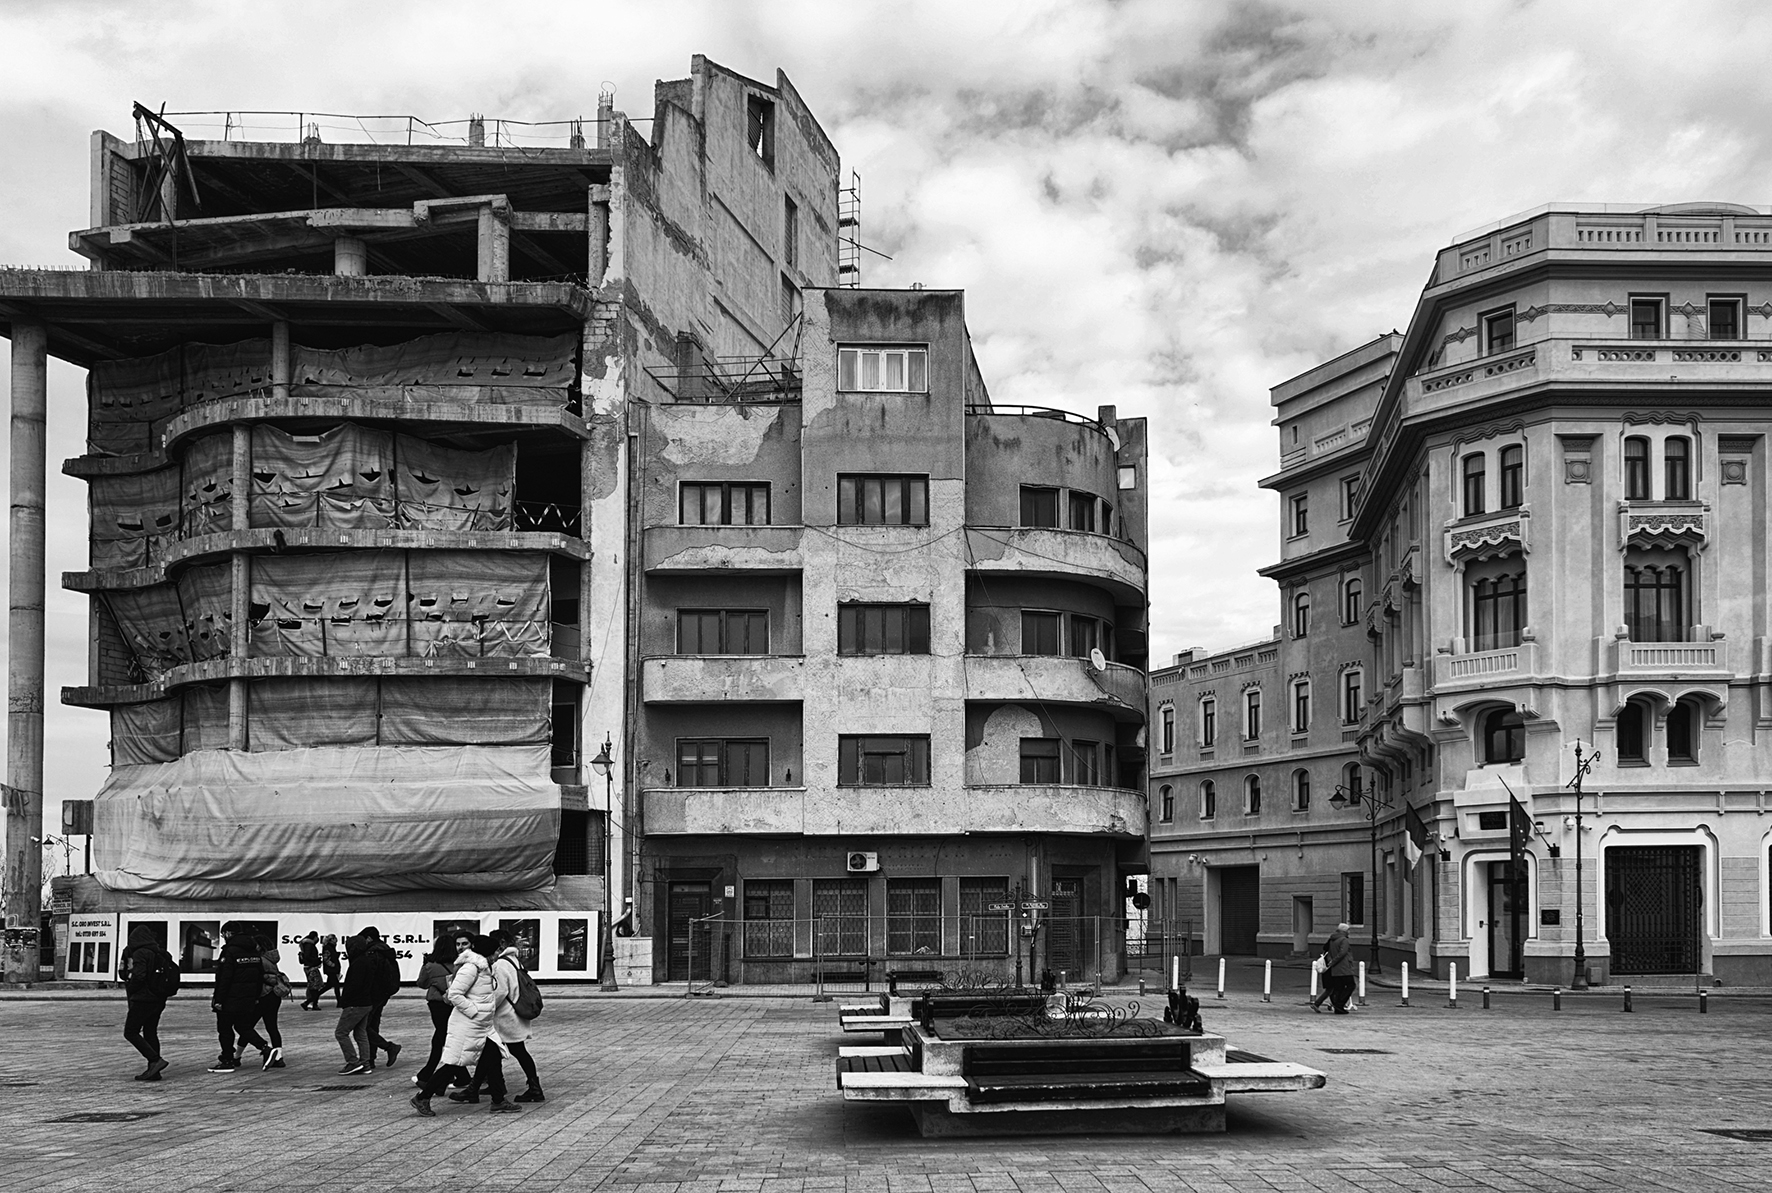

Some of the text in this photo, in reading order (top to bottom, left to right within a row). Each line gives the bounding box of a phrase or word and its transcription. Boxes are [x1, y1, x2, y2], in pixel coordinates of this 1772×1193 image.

[281, 935, 302, 944] S.C
[393, 934, 430, 943] S.R.L.
[395, 950, 413, 959] 54
